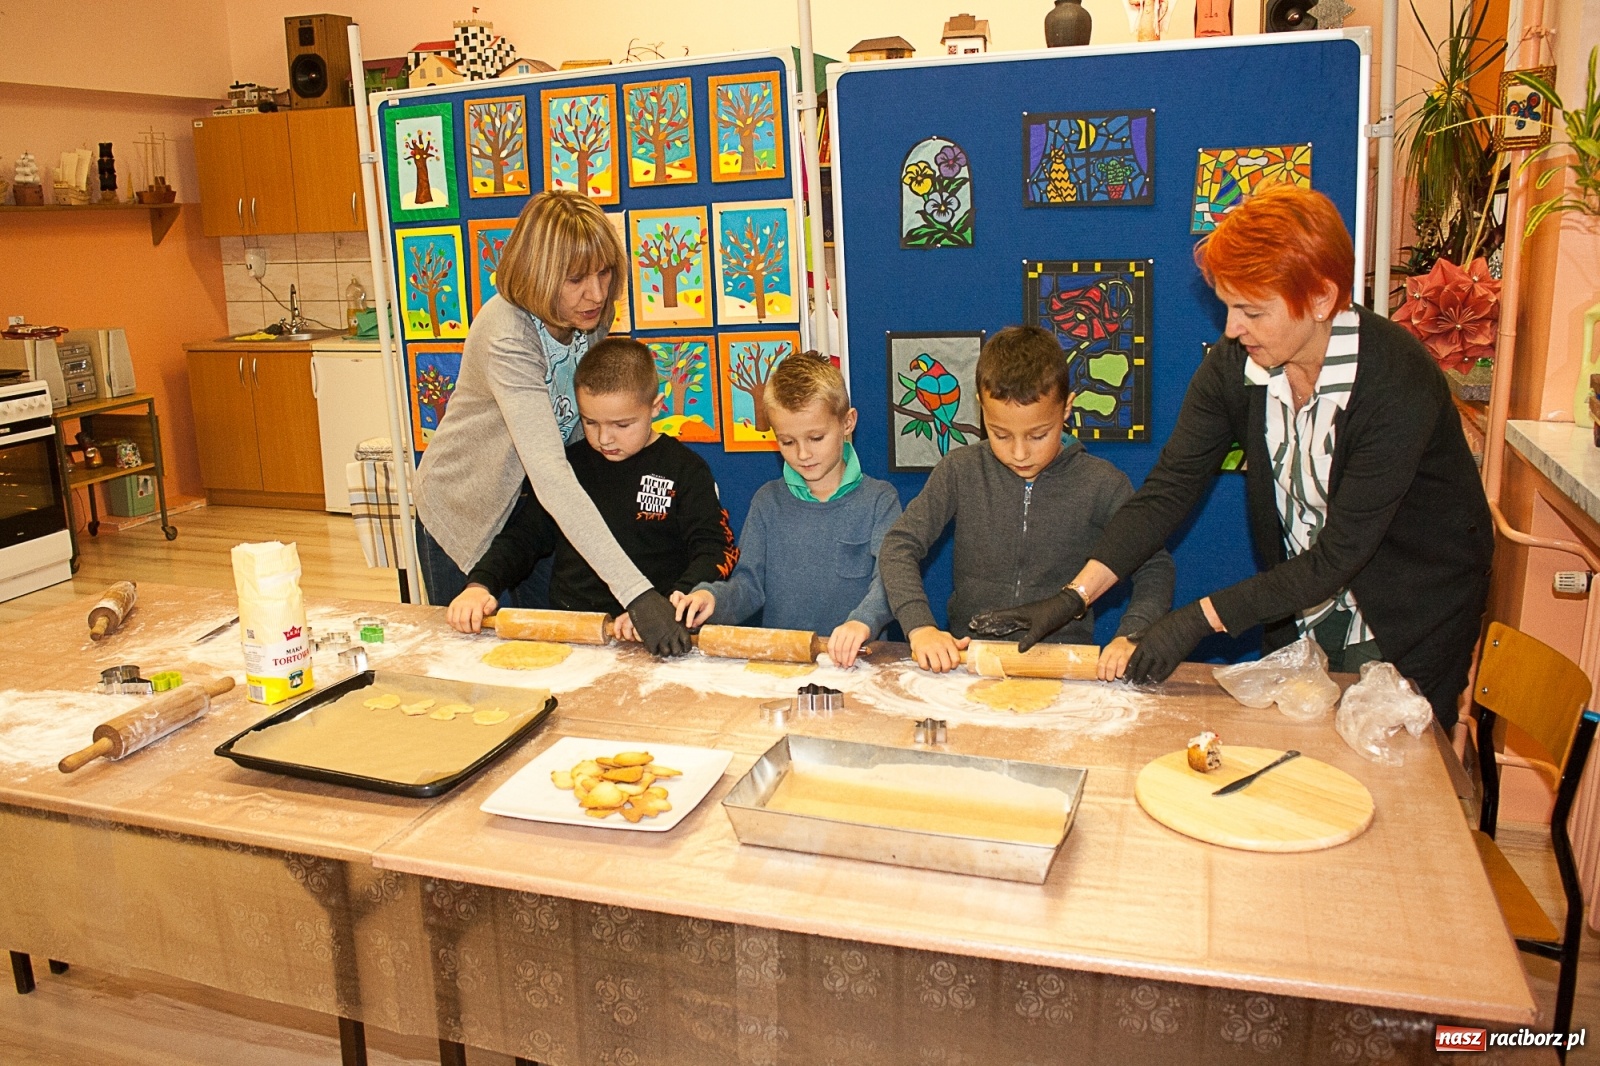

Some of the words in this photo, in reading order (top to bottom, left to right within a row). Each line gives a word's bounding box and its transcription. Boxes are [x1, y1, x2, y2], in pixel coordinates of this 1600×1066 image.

[642, 477, 670, 497] NEW
[639, 494, 668, 514] YORK
[636, 511, 668, 521] STATE
